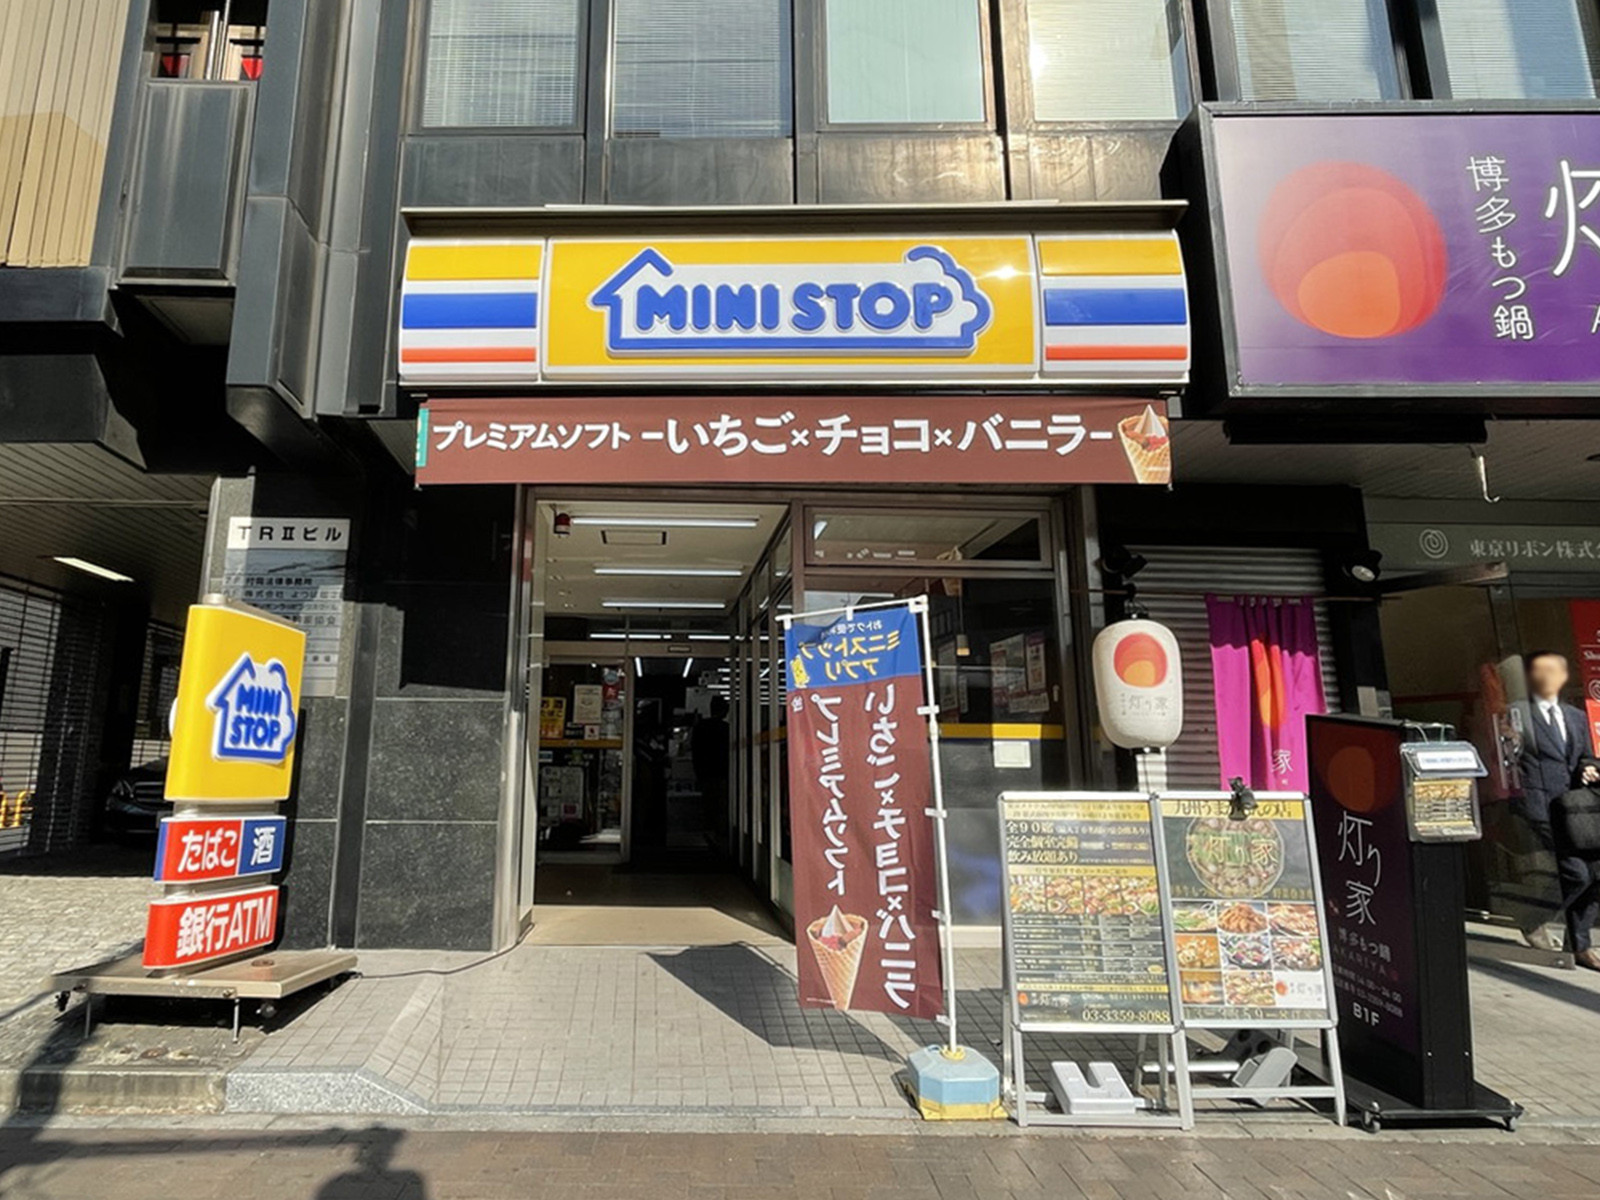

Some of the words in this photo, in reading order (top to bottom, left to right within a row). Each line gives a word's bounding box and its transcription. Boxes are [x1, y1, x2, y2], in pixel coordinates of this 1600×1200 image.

[1465, 155, 1535, 341] 博多もつ鍋
[635, 283, 780, 332] MINI
[792, 281, 955, 332] STOP
[432, 421, 632, 453] プレミアムソフト
[234, 682, 282, 719] MINI
[229, 716, 282, 749] STOP
[177, 827, 239, 873] たばこ
[249, 826, 276, 866] 酒
[1337, 810, 1382, 926] 灯り家
[175, 895, 274, 960] 銀行ATM
[1082, 1009, 1170, 1023] 03-3359-8088
[1352, 1001, 1380, 1027] B1F
